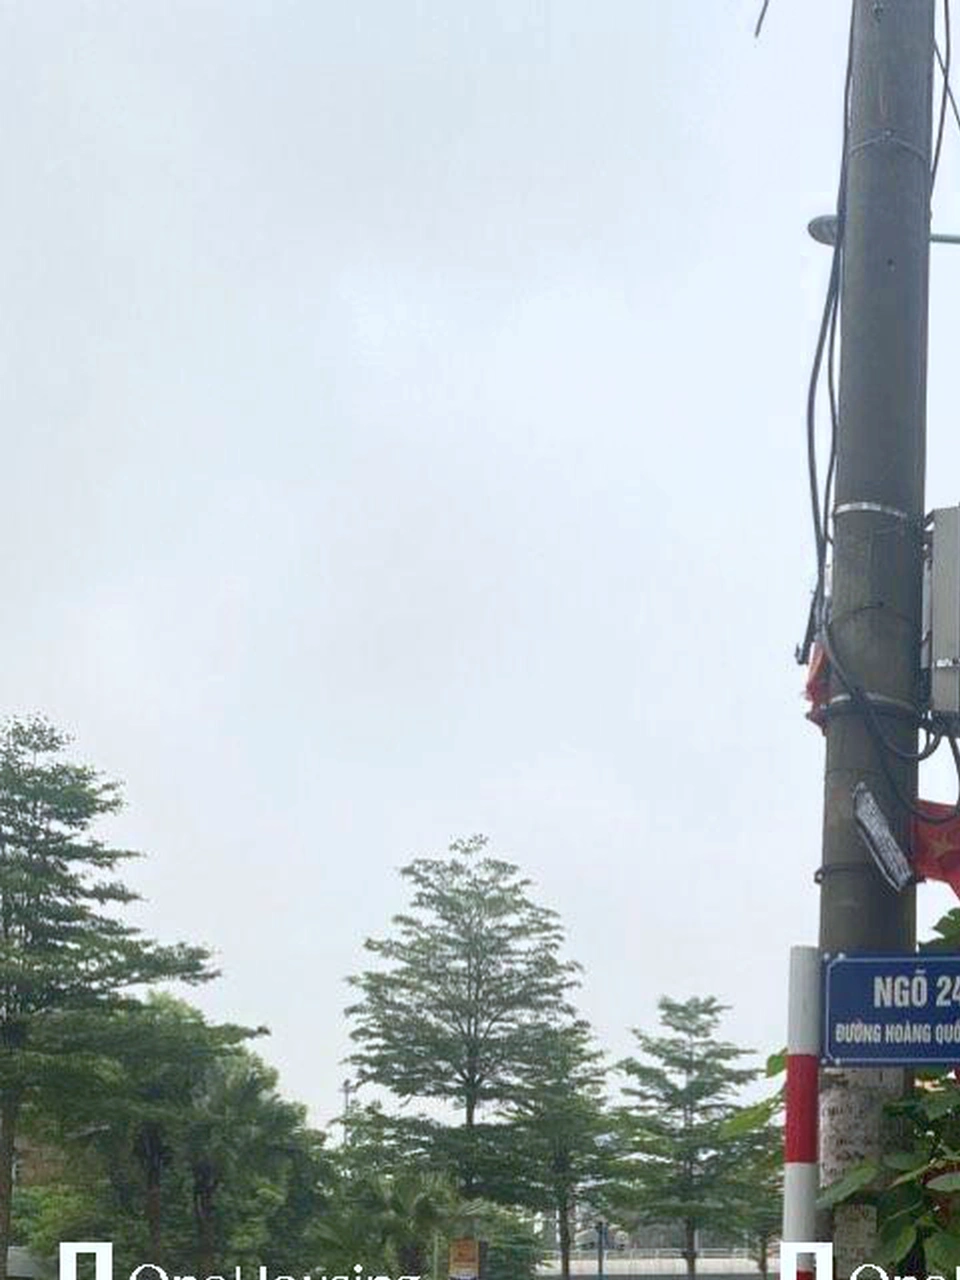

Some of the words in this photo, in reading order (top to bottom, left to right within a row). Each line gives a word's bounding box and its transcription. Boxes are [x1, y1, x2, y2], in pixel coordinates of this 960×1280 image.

[874, 968, 928, 1008] NGÕ
[835, 1019, 881, 1044] ĐƯỜNG
[885, 1019, 931, 1044] HOÀNG
